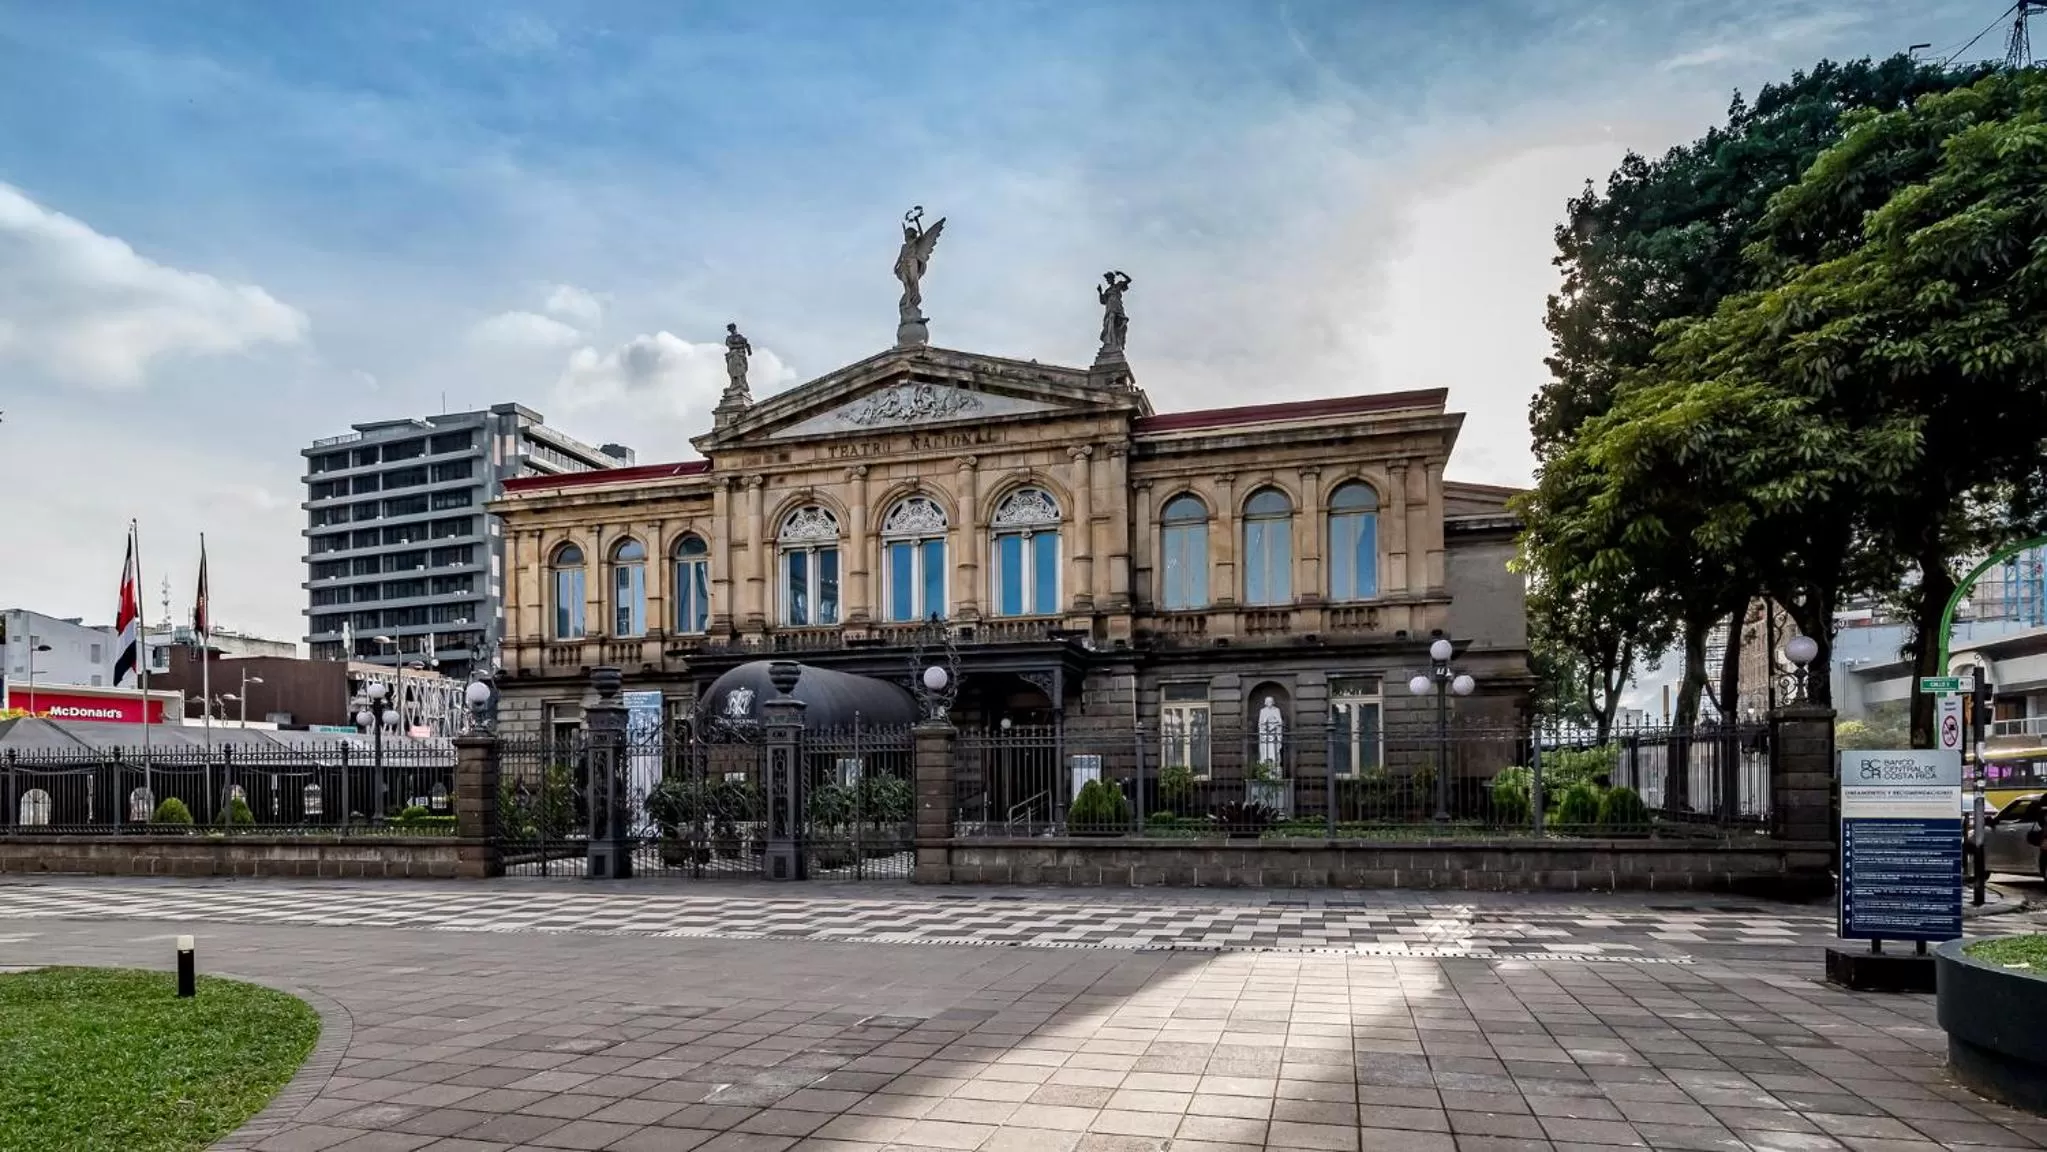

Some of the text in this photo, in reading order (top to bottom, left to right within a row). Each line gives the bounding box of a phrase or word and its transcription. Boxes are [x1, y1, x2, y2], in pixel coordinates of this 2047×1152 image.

[828, 431, 994, 458] TEATRO NACIONAL
[50, 706, 123, 719] McDonald's
[1884, 772, 1914, 780] COSTA
